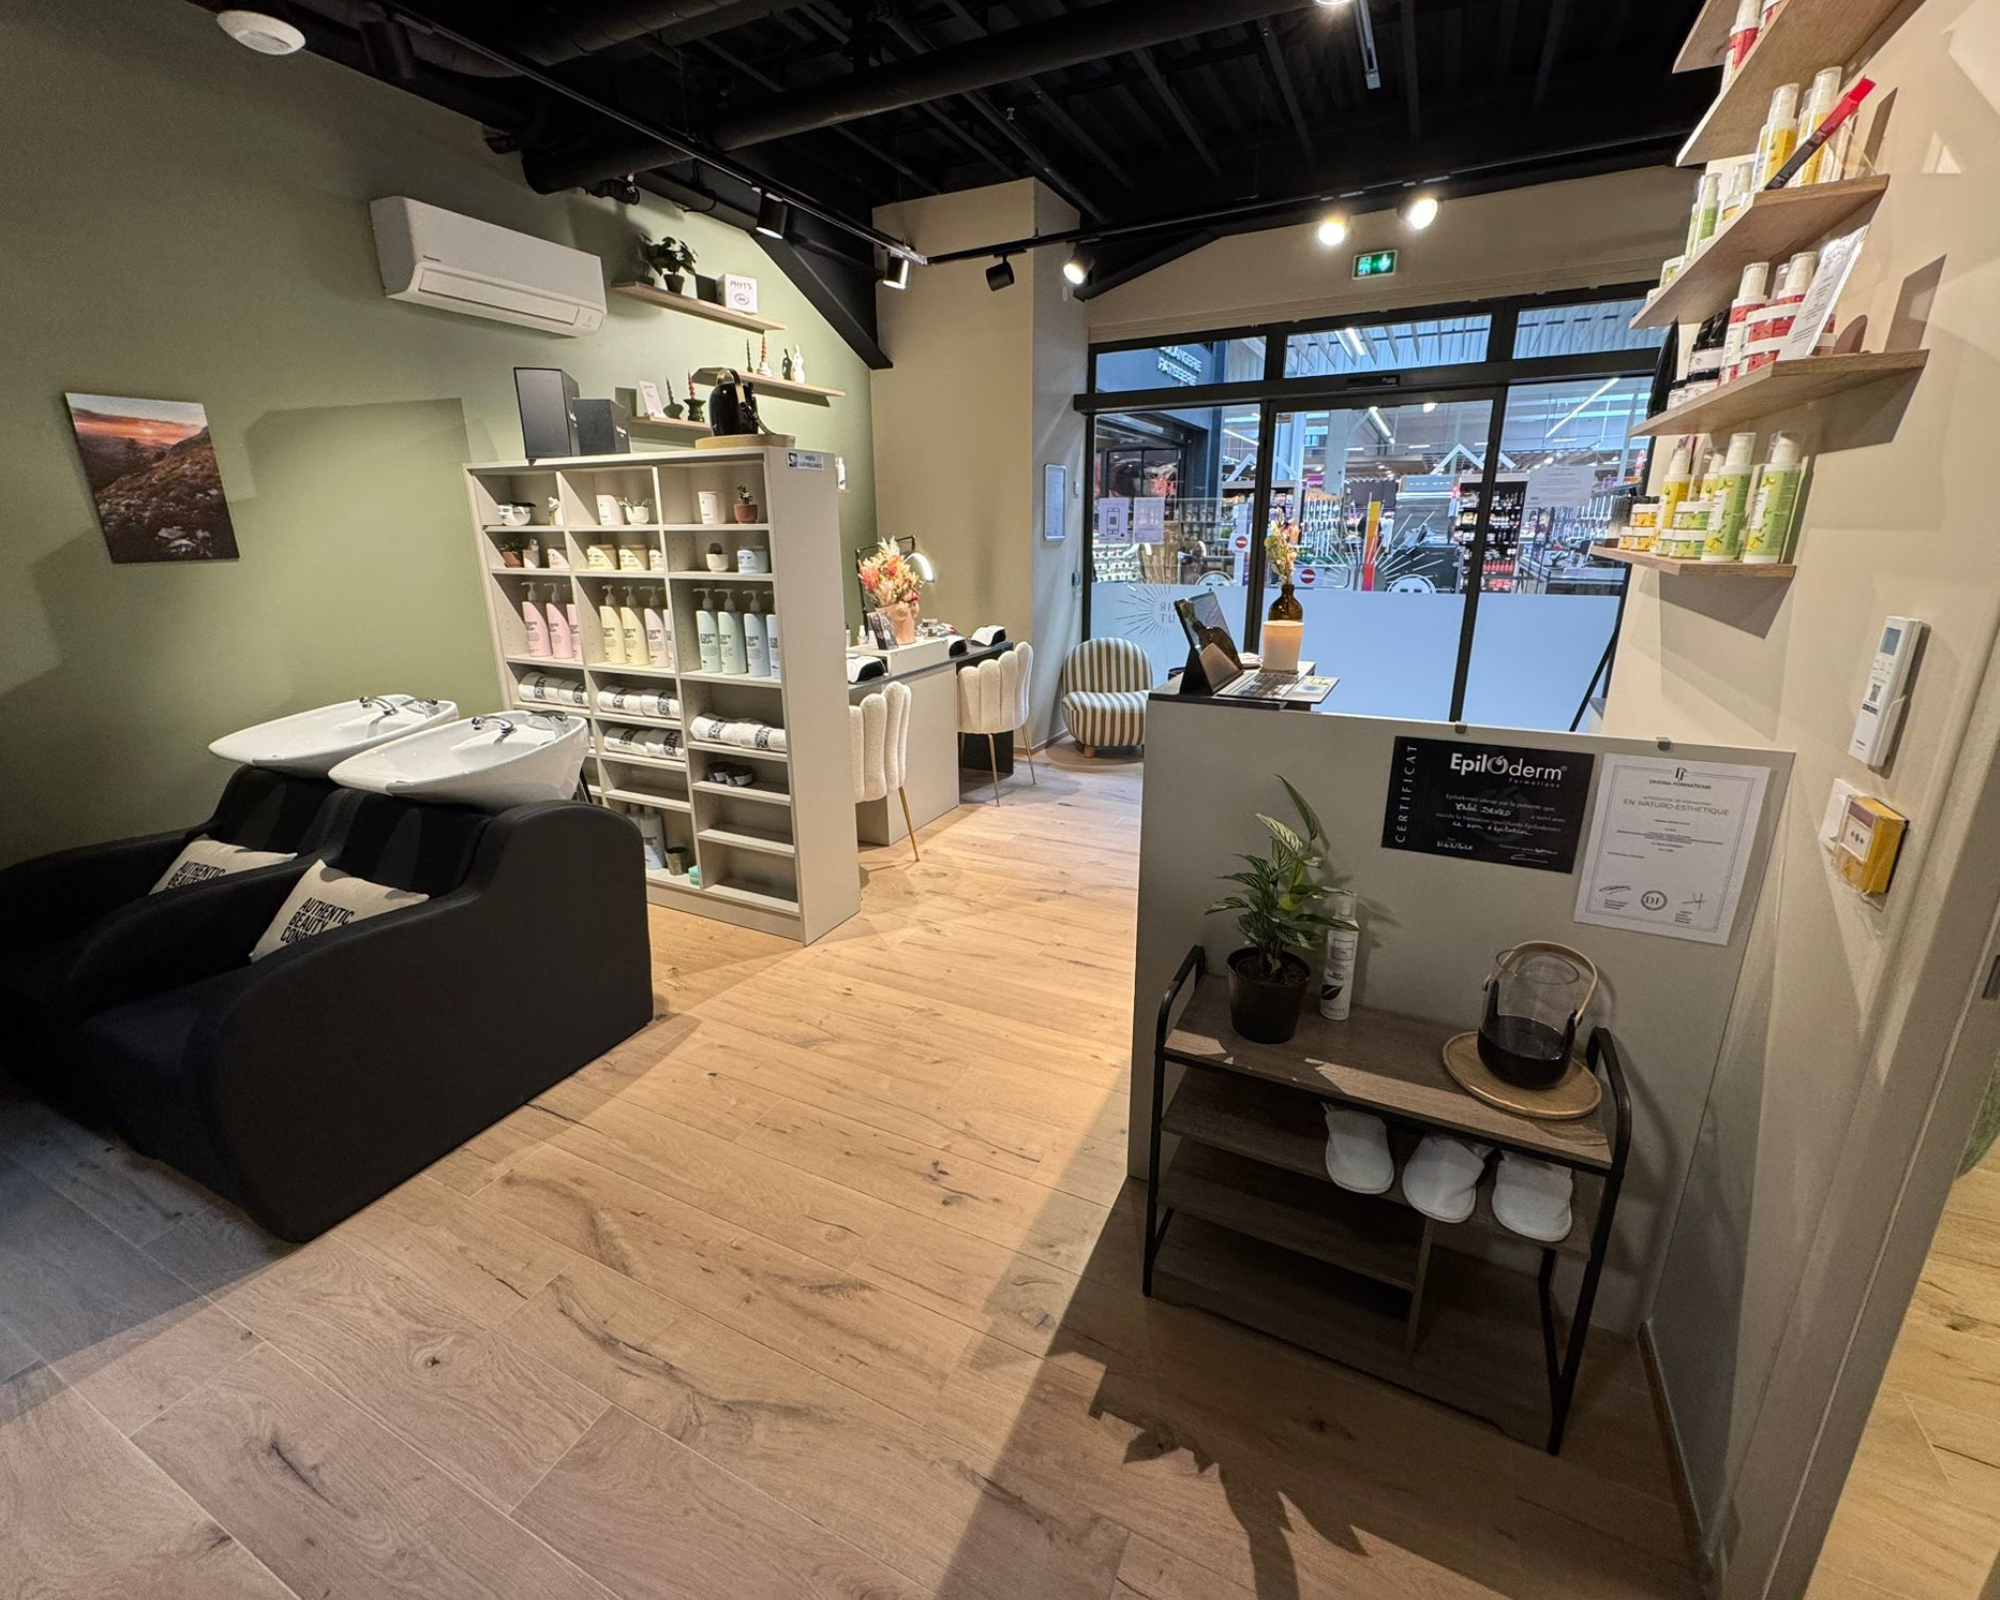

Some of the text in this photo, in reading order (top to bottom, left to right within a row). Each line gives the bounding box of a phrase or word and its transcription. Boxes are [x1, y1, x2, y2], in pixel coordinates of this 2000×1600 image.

[1395, 746, 1417, 843] CERTIFICAT
[1623, 798, 1636, 806] EN
[288, 911, 330, 934] BEAUTY
[299, 897, 355, 925] AUTHENTIC
